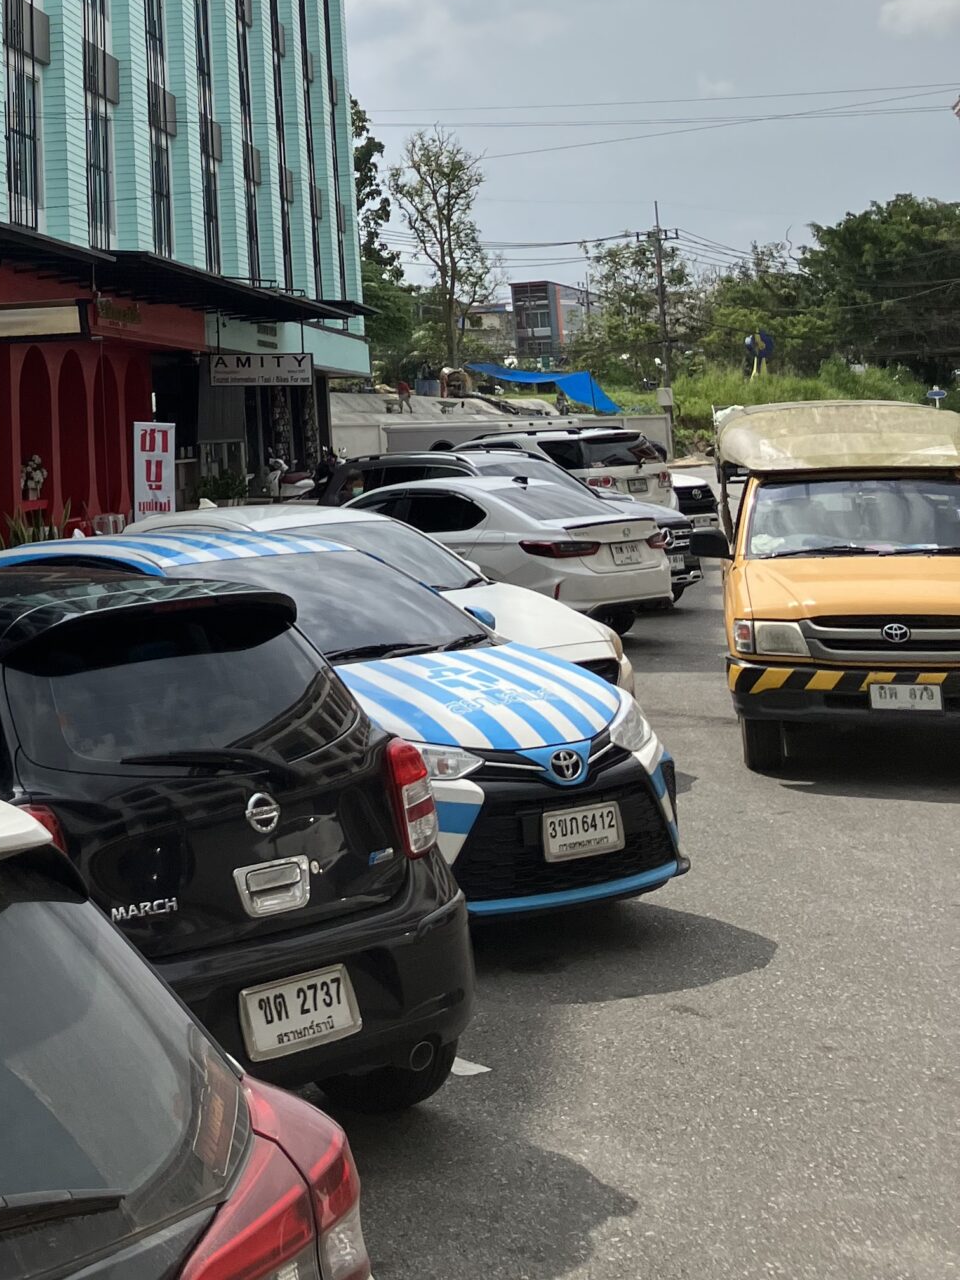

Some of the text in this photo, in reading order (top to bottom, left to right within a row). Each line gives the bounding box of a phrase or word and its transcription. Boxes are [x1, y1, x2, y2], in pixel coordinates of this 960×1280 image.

[214, 356, 306, 368] AMITY
[290, 375, 298, 383] For
[141, 428, 168, 453] ชา
[145, 460, 162, 490] บู
[581, 810, 615, 833] 6412
[111, 897, 178, 921] MARCH
[296, 977, 341, 1015] 2737
[277, 1015, 334, 1044] สราษฎร์ธานี
